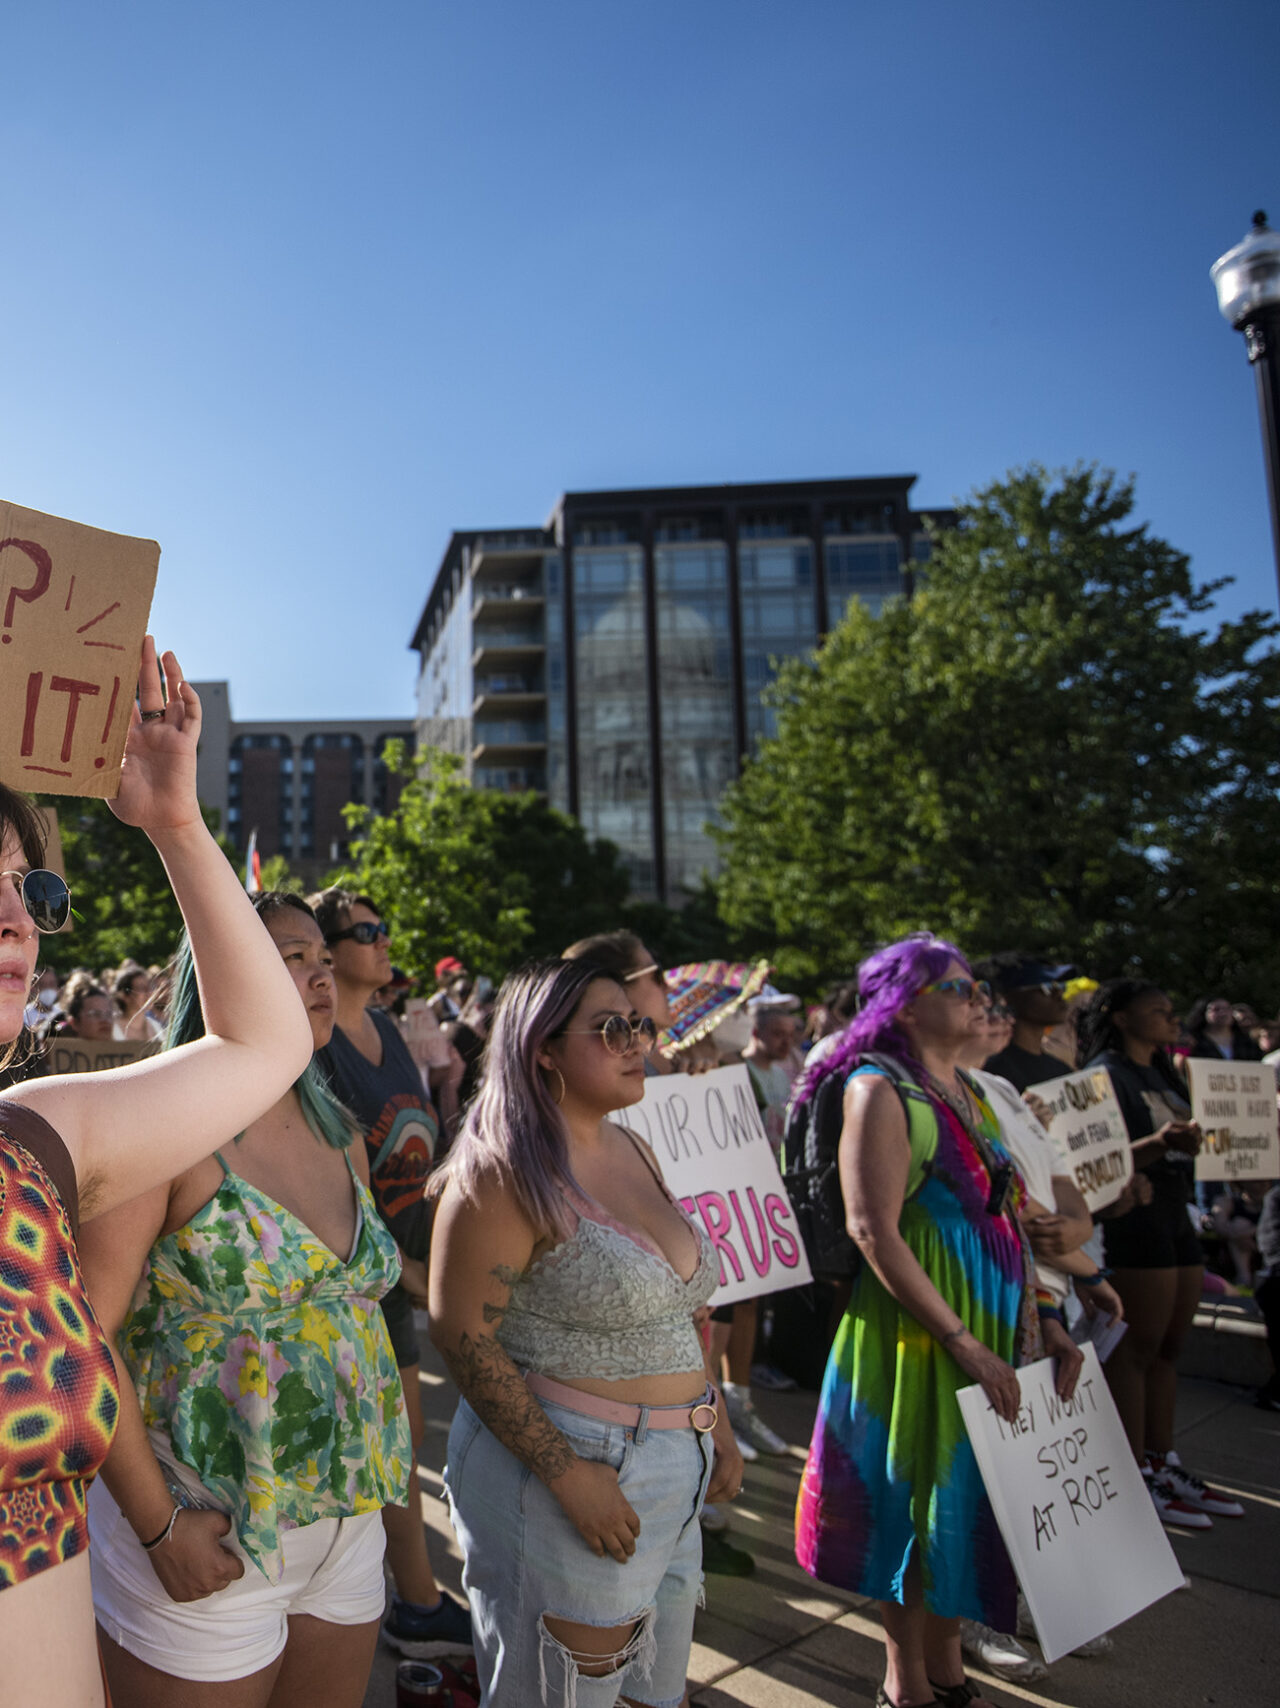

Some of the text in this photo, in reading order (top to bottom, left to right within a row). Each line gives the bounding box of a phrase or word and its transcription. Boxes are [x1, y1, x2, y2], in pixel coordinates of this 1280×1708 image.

[20, 671, 120, 770] IT!
[680, 1186, 800, 1288] RUS
[1037, 1427, 1088, 1479] STOP
[1032, 1466, 1119, 1551] AT ROE
